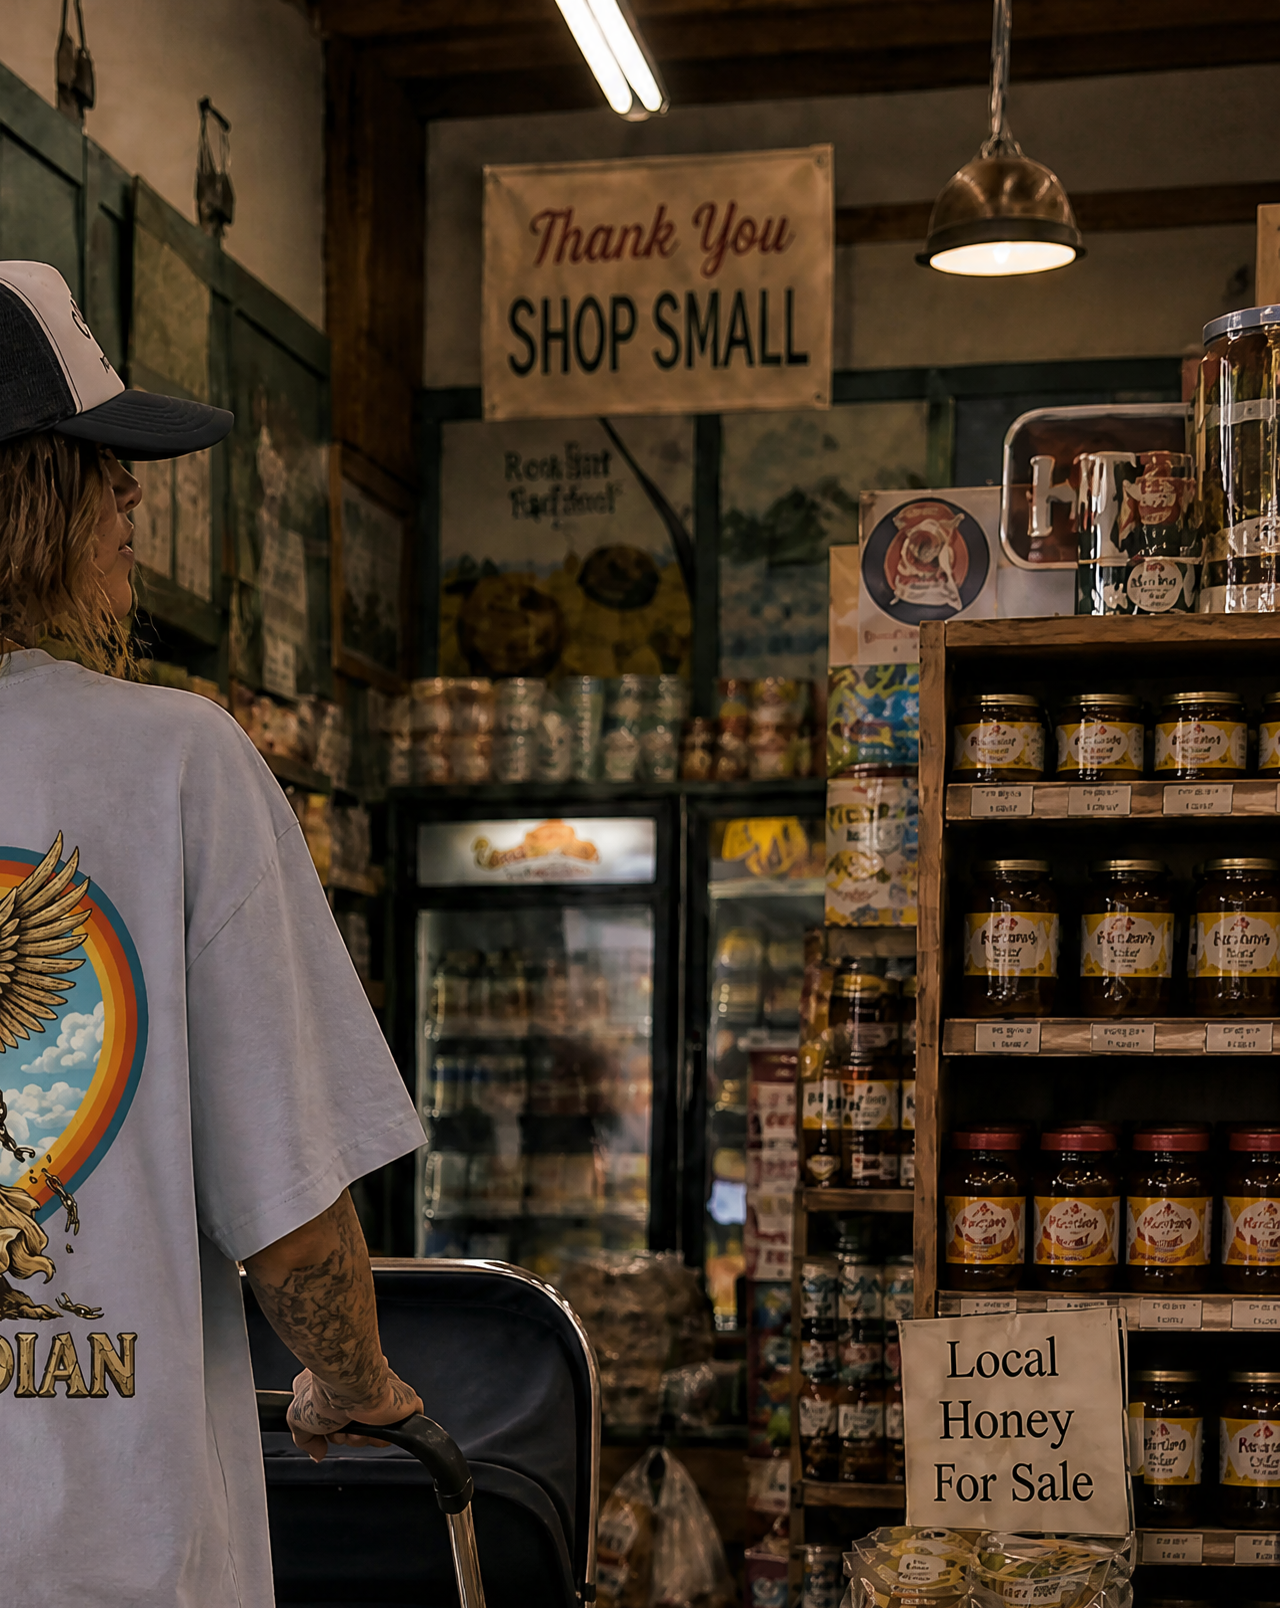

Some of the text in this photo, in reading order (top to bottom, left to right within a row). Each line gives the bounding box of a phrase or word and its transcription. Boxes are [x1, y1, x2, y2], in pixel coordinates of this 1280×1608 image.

[529, 199, 796, 279] Thank You
[507, 285, 810, 377] SHOP SMALL
[946, 1336, 1059, 1378] Local
[939, 1400, 1075, 1449] Honey
[933, 1460, 1094, 1502] For Sale
